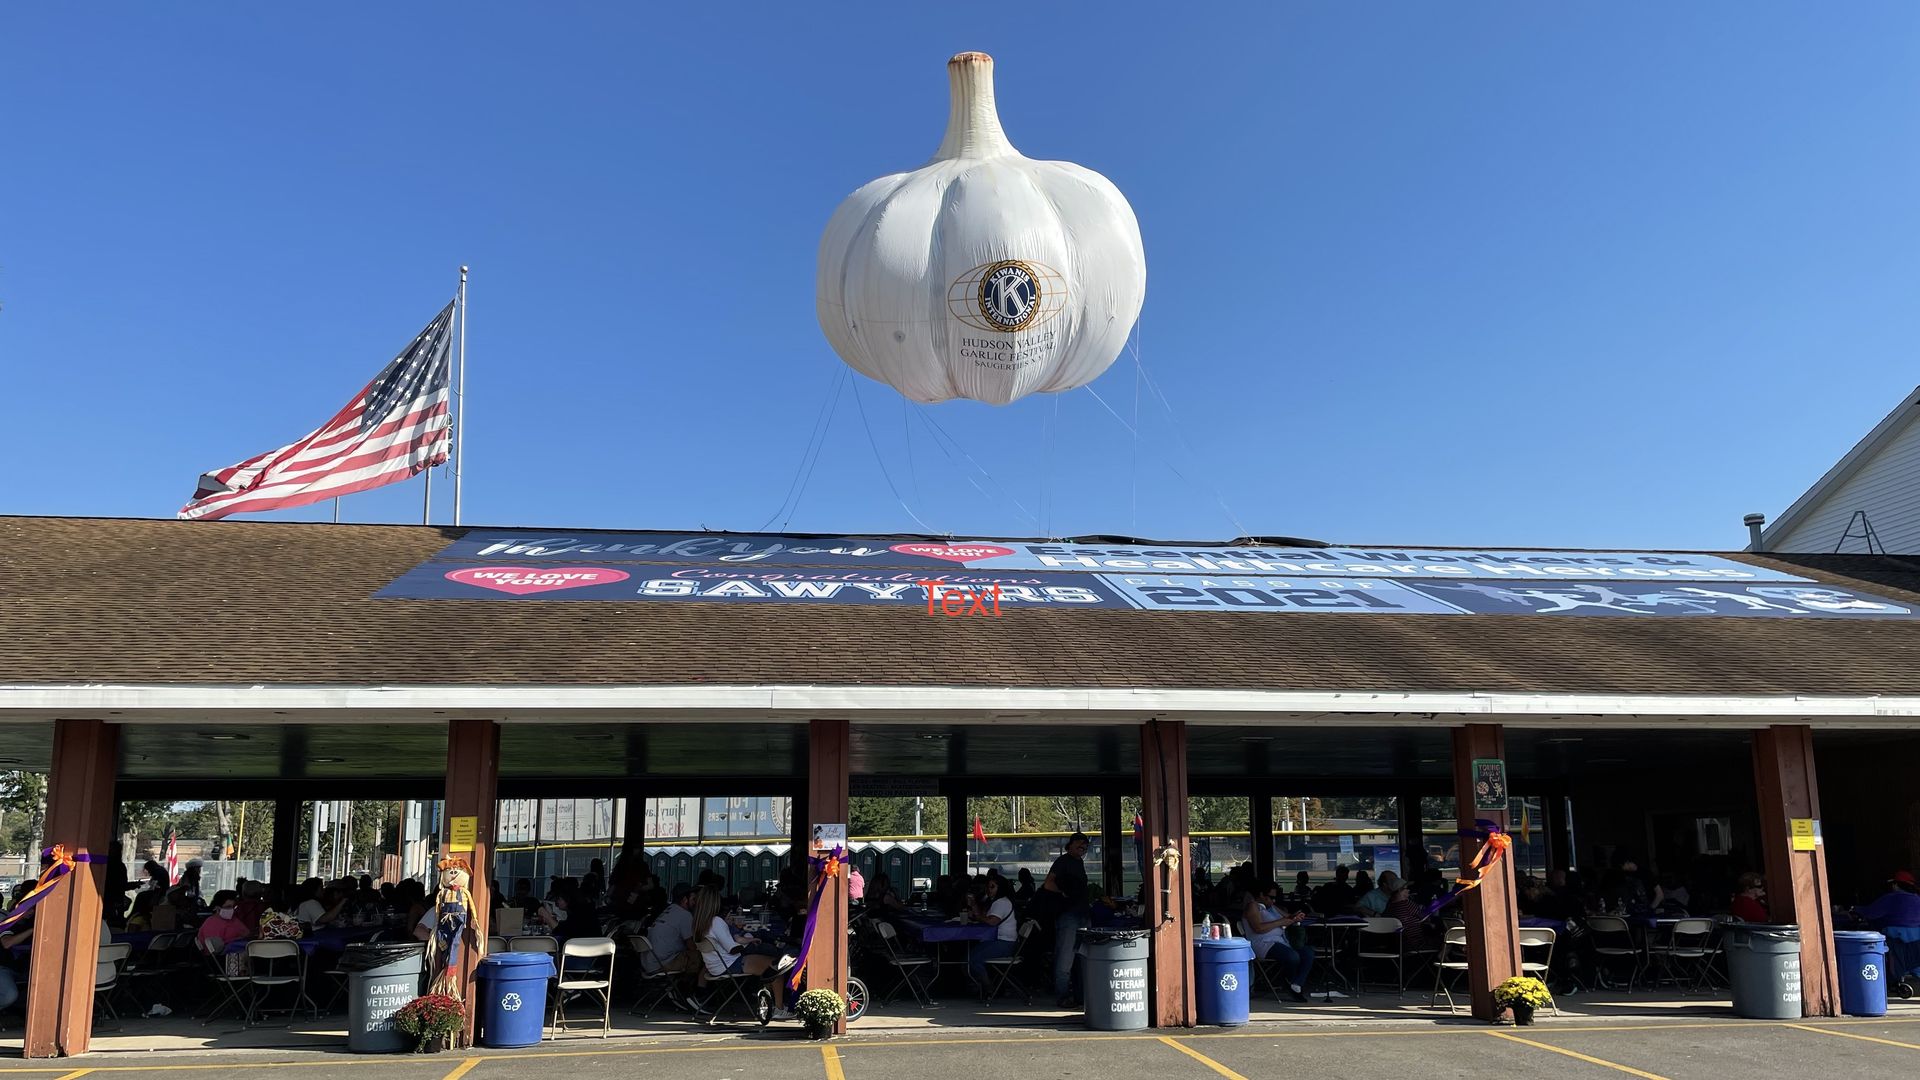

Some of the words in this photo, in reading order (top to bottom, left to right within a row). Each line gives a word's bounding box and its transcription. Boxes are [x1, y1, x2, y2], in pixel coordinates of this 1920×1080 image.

[990, 267, 1030, 284] KIWANIS
[996, 276, 1027, 317] K
[984, 294, 1036, 326] INTERNATIONAL
[963, 338, 1014, 350] HUDSON
[1017, 330, 1056, 349] VALLEY
[960, 349, 1007, 361] GARLIC
[1010, 342, 1056, 362] FESTIVAL
[974, 360, 1028, 371] SAUGERTIES
[1025, 546, 1340, 560] Essential
[1338, 552, 1633, 564] Workers
[1636, 556, 1697, 566] &
[1035, 554, 1472, 574] Healthcare
[1474, 564, 1756, 578] Heroes
[496, 578, 566, 586] YOU!
[526, 572, 598, 580] LOVE
[671, 568, 1048, 585] Congratulations
[1124, 578, 1292, 588] CLASS
[637, 579, 1104, 603] SAWYERS
[1136, 586, 1406, 608] 2021
[1113, 968, 1143, 978] CANTINE
[370, 984, 410, 994] CANTINE
[1110, 979, 1145, 989] VETERANS
[366, 995, 412, 1007] VETERANS
[1114, 991, 1142, 1000] SPORTS
[1111, 1002, 1144, 1012] COMPLEX
